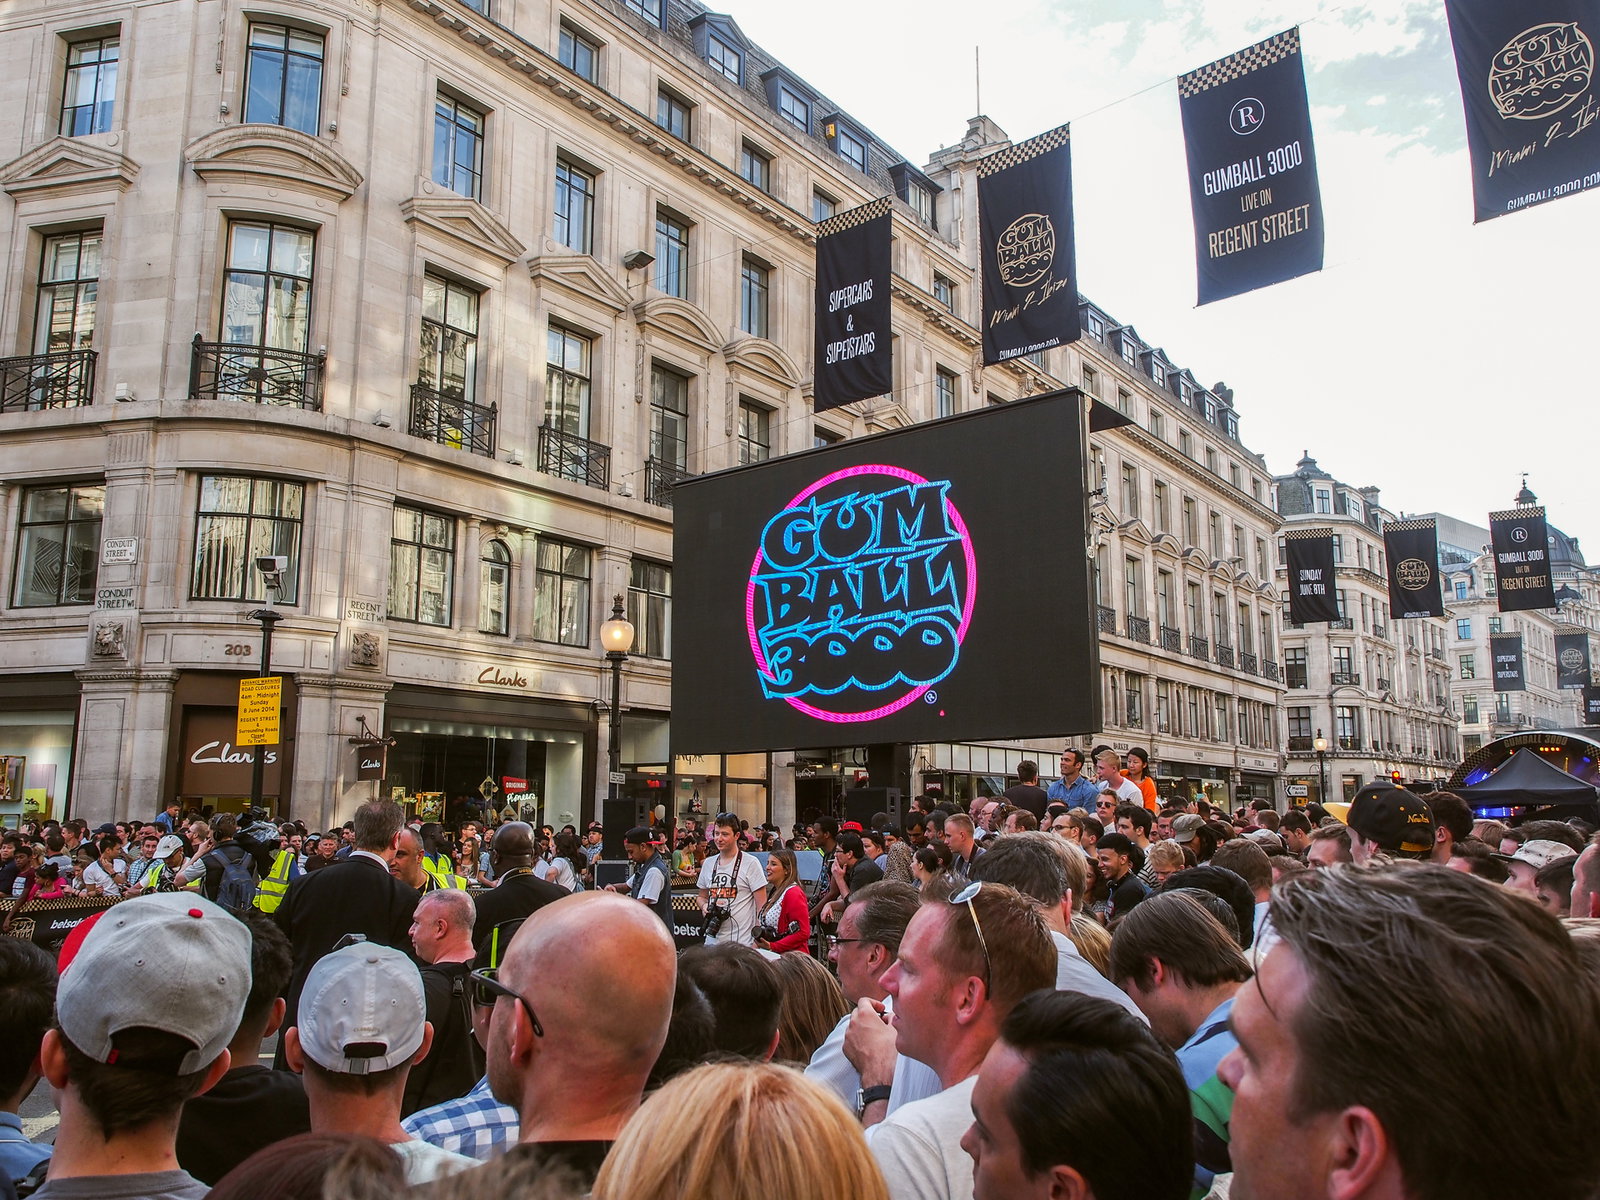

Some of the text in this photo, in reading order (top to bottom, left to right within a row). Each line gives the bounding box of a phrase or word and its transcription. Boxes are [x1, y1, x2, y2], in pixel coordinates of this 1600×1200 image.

[1544, 121, 1568, 147] 2
[1568, 95, 1600, 138] Ibi
[1203, 140, 1303, 196] GUMBALL 3000
[1241, 188, 1272, 212] LIVE ON
[1208, 204, 1310, 259] REGENT STREET
[829, 279, 873, 312] SUPERCARS
[846, 314, 854, 331] &
[826, 331, 875, 364] SUPERSTARS
[106, 540, 133, 549] CONDUIT
[105, 550, 127, 558] STREET
[1499, 550, 1544, 564] GUMBALL 3000
[1300, 569, 1322, 581] SUNDAY
[1300, 583, 1326, 595] JUNE 8TH
[1502, 575, 1547, 590] REGENT STREET
[98, 588, 133, 599] CONDUIT
[97, 599, 127, 609] STREET
[351, 600, 382, 613] REGENT
[347, 610, 375, 622] STREET
[225, 644, 251, 656] 203
[477, 666, 528, 688] Clarks
[1113, 742, 1130, 751] BARKER
[1503, 734, 1568, 748] GUMBALL 3000
[191, 740, 278, 764] Clars
[361, 759, 381, 769] Clarks
[50, 917, 85, 930] betsaf
